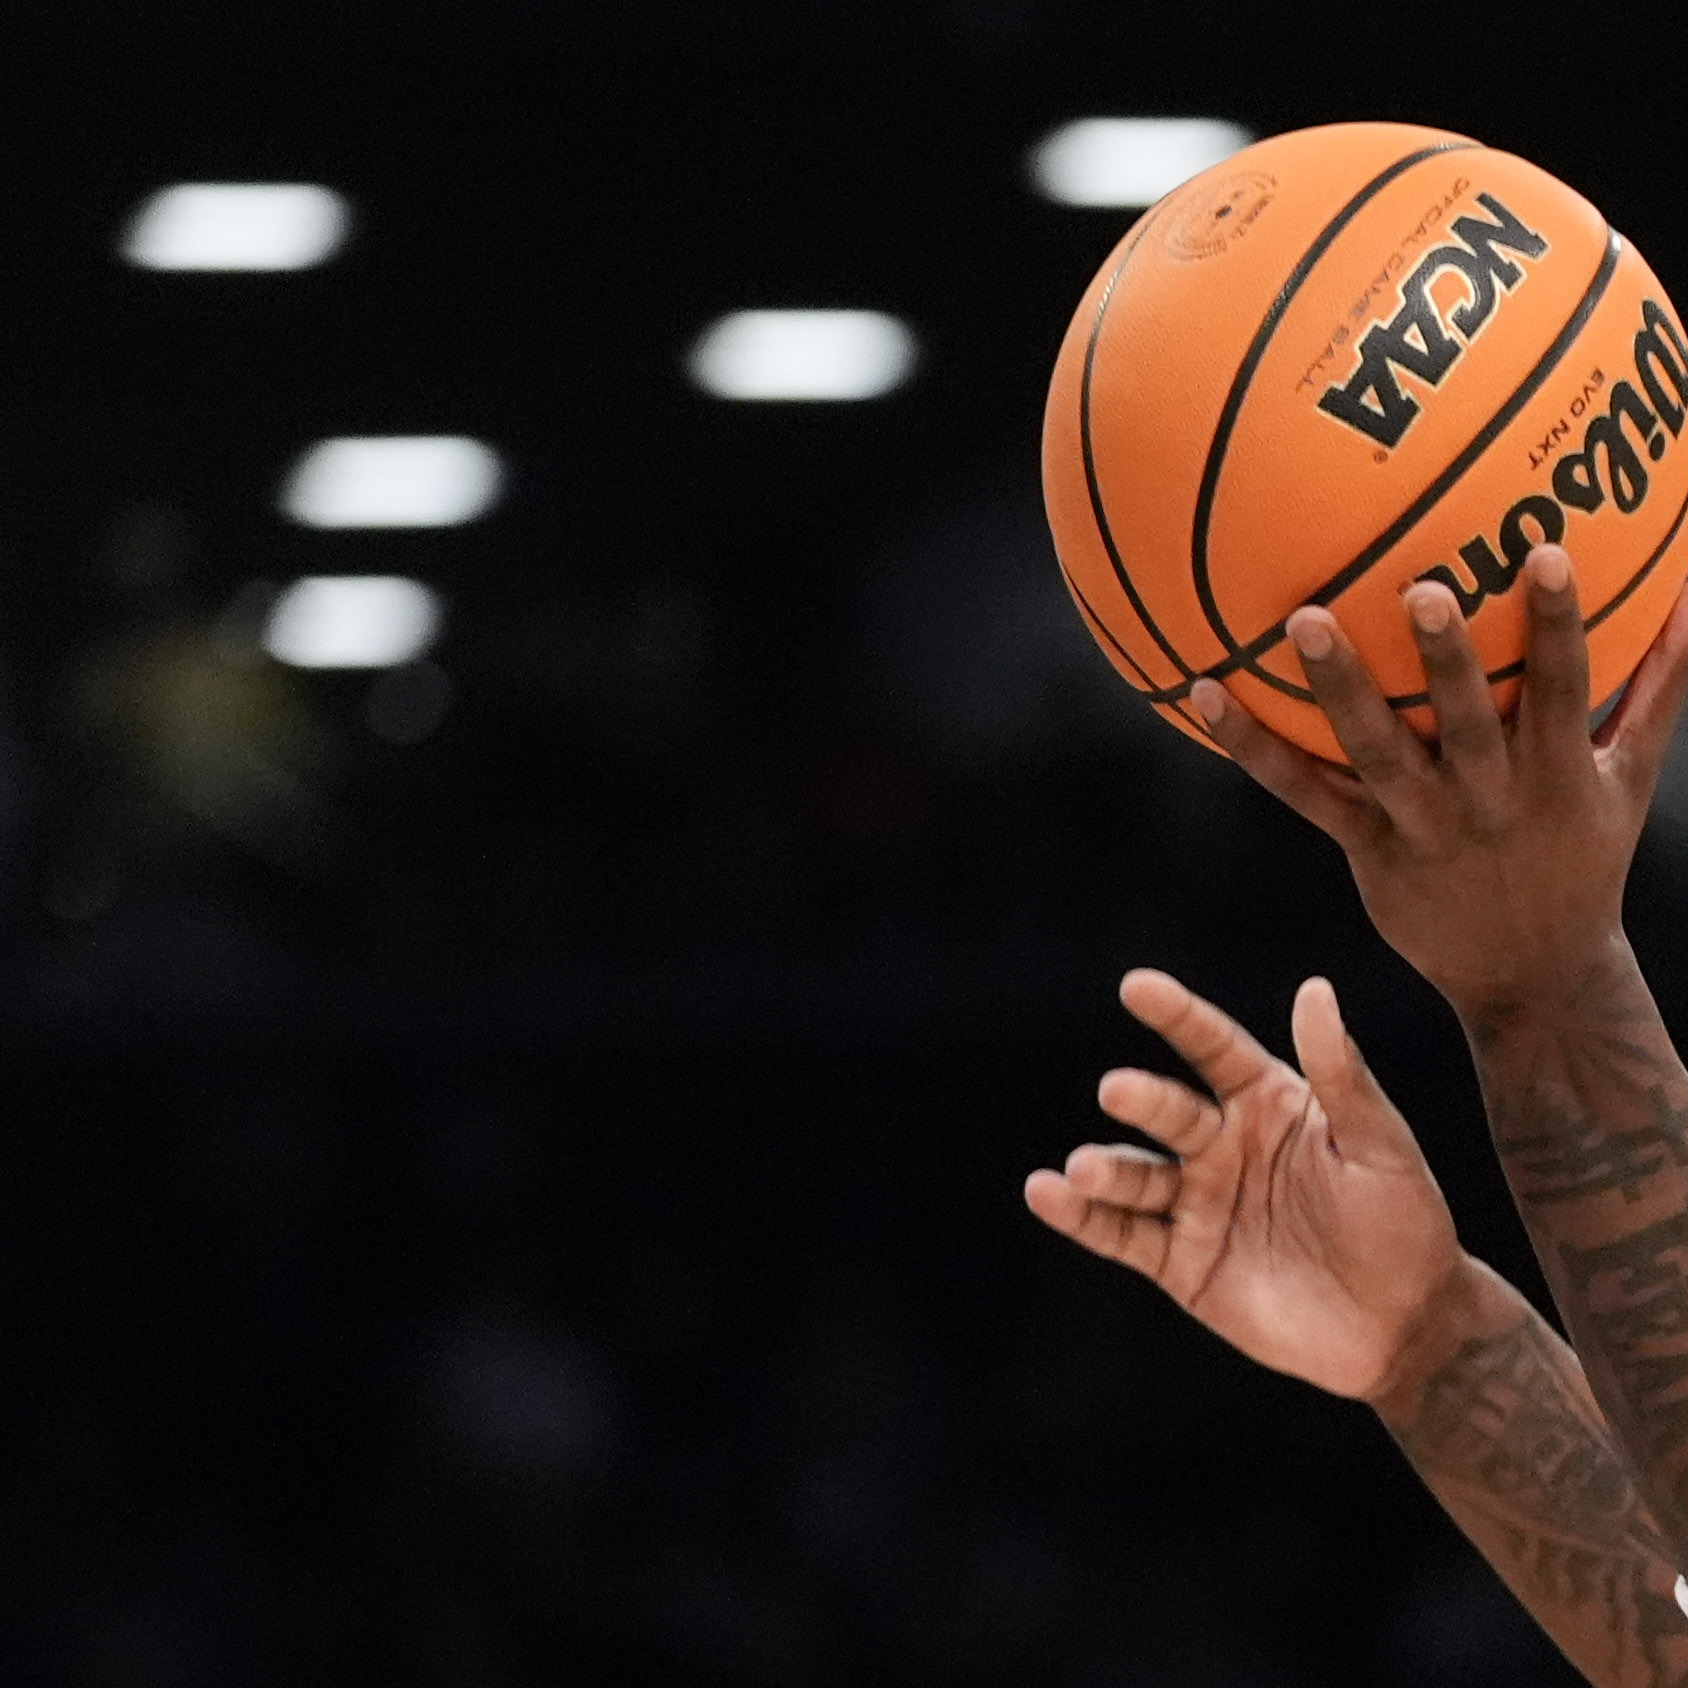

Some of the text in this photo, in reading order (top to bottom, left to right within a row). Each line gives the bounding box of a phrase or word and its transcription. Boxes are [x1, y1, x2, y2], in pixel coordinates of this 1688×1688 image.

[1316, 192, 1552, 450] NCAA
[1528, 367, 1605, 471] EVO NXT
